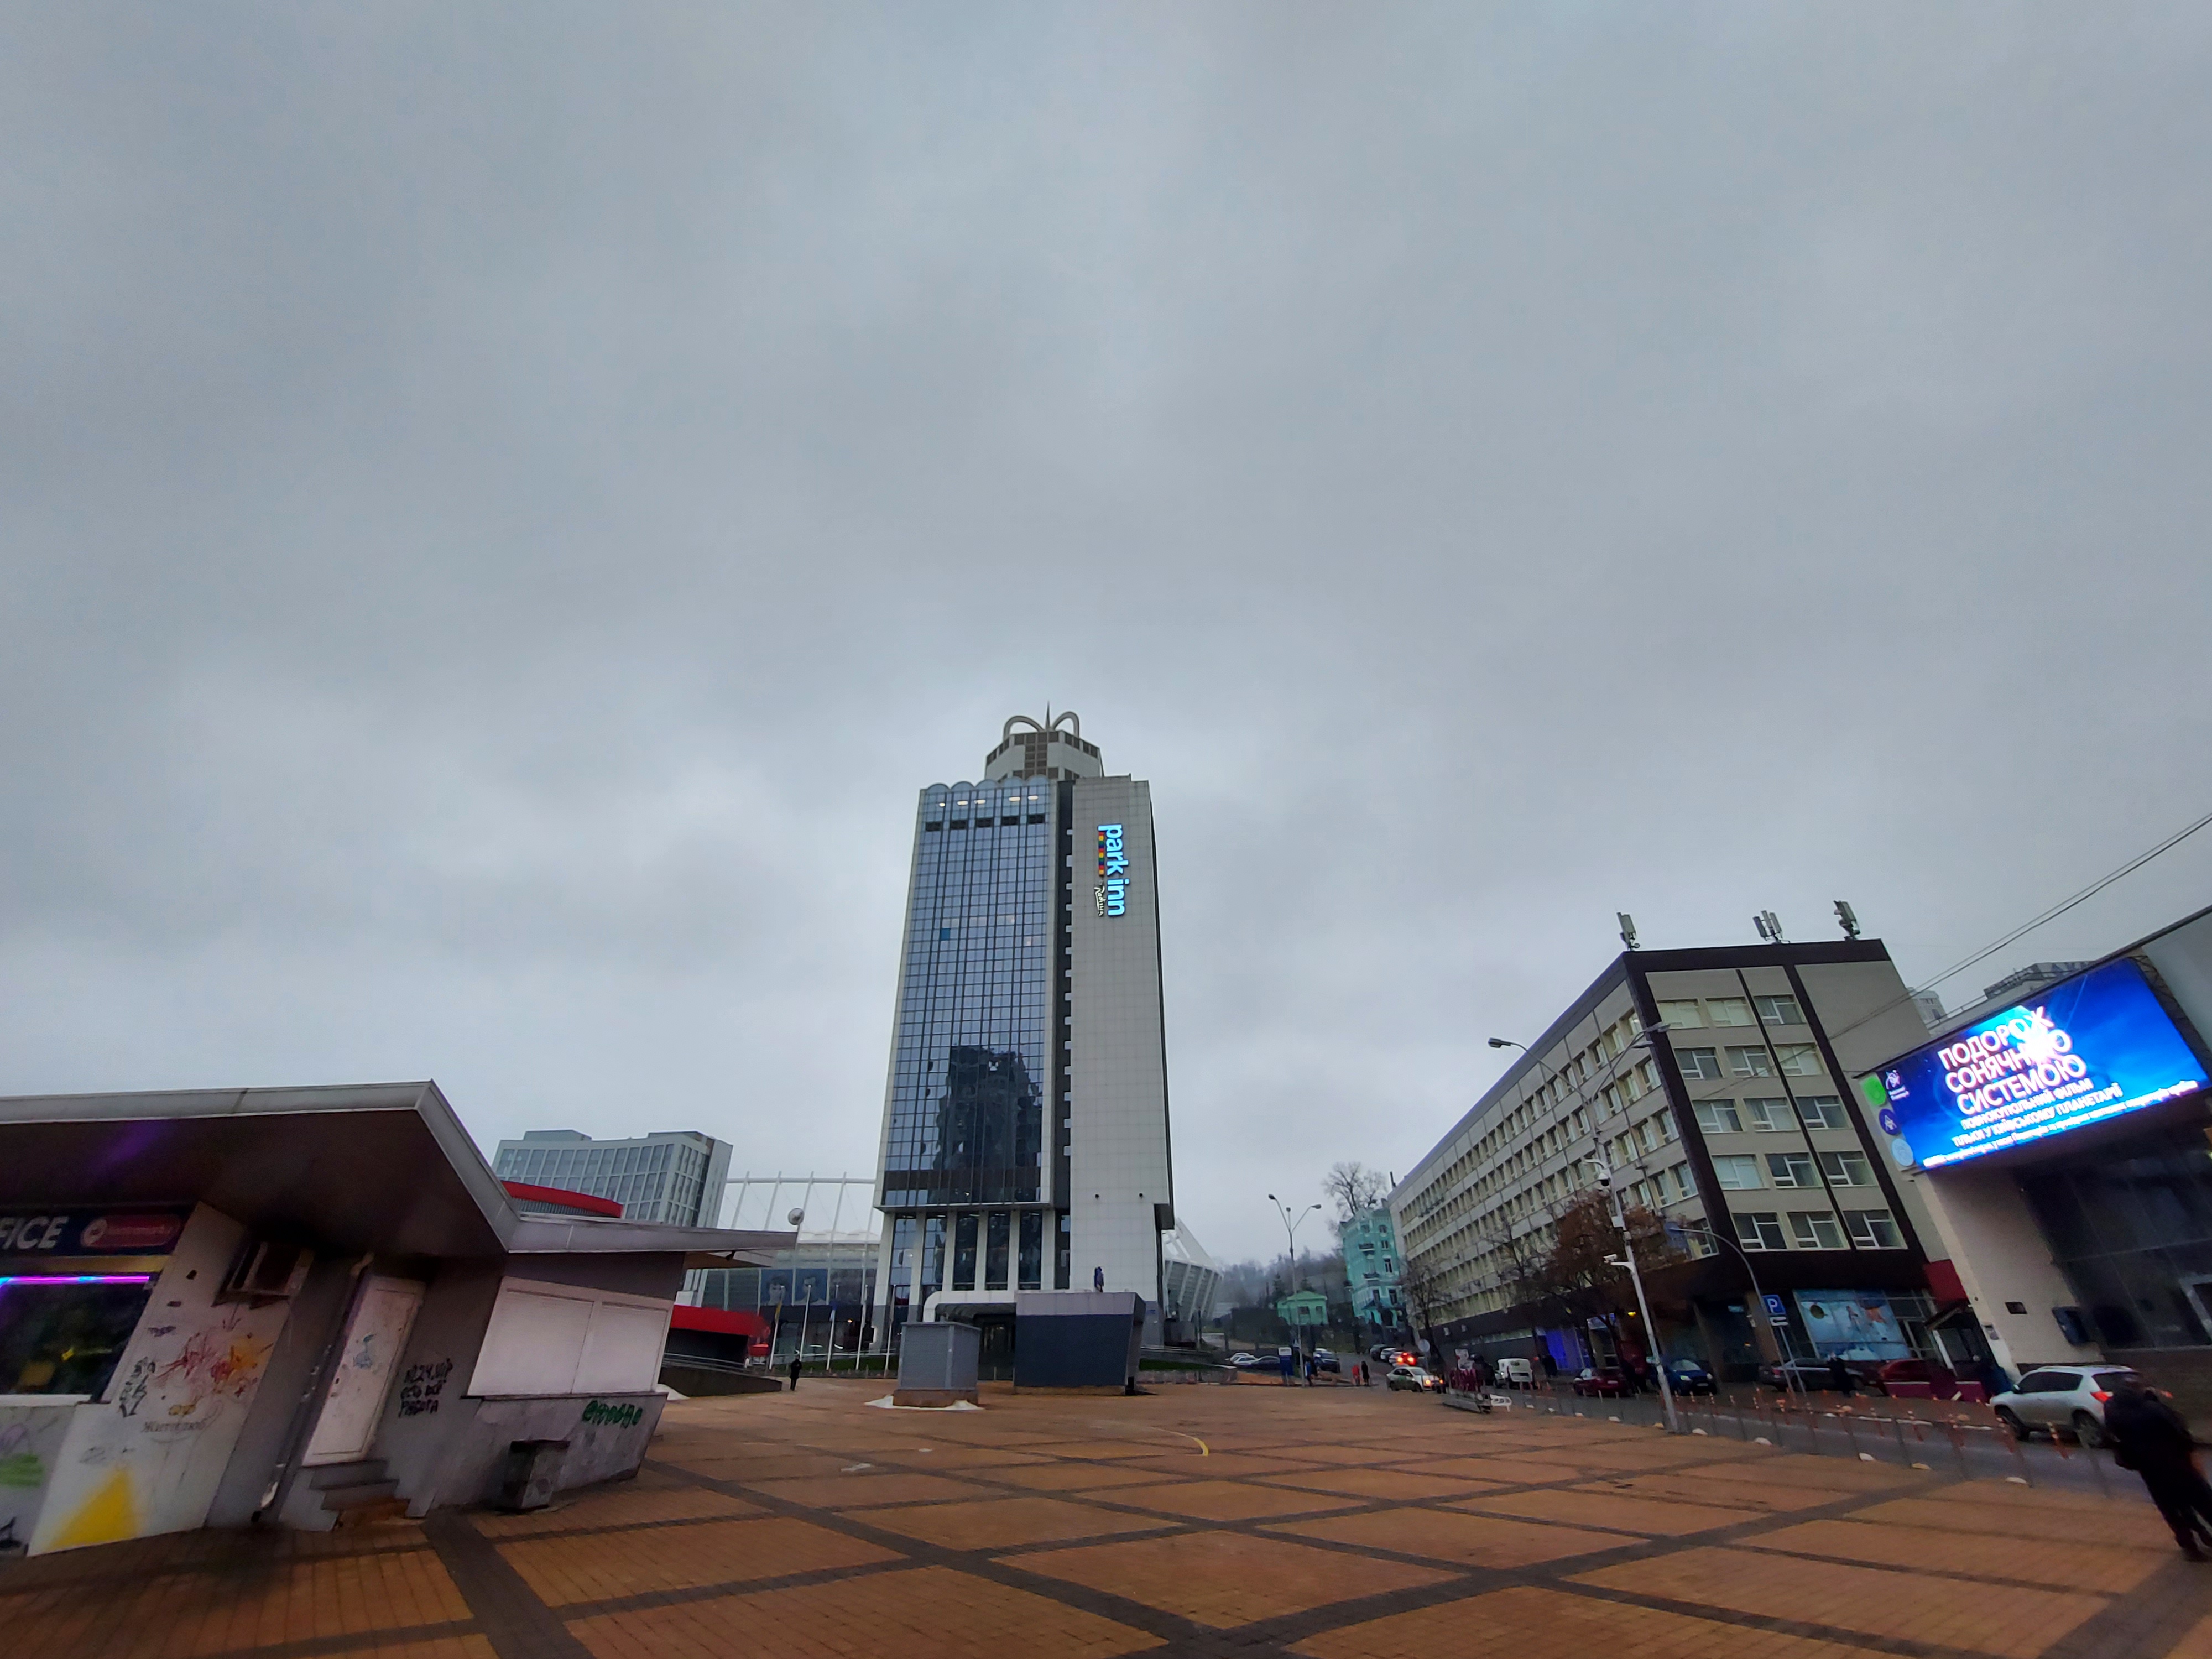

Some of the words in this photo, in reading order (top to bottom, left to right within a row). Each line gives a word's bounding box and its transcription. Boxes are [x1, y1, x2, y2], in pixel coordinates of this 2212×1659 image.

[1098, 825, 1129, 876] park
[1107, 878, 1129, 916] inn
[1938, 1006, 2054, 1070] ПОДОРОЖ
[1945, 1029, 2073, 1093] СОНЯЧНЮ
[1957, 1054, 2087, 1115] СИСТЕМОЮ
[1767, 1298, 1777, 1314] P
